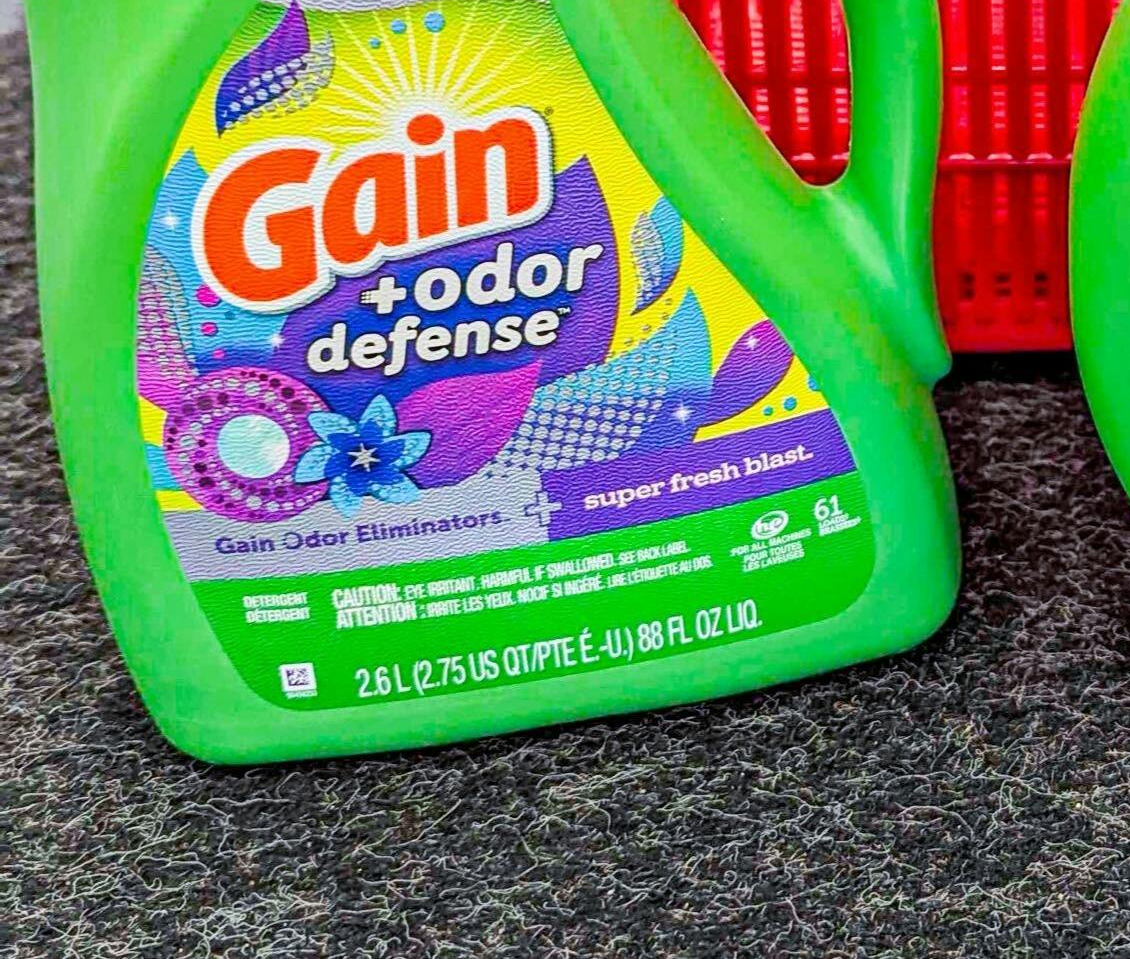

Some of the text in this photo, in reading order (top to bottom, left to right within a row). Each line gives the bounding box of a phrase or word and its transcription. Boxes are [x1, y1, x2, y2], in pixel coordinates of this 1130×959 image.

[201, 111, 543, 305] Gain
[583, 480, 666, 511] super
[667, 463, 741, 495] fresh
[814, 494, 843, 522] 61
[215, 533, 276, 555] Gain
[282, 528, 350, 550] Odor
[769, 528, 812, 547] MACHINES
[241, 590, 309, 609] DETERGENT
[331, 582, 403, 610] CAUTION:
[404, 583, 427, 601] EYE
[480, 567, 532, 591] HARMFUL
[533, 564, 547, 583] IF
[336, 600, 418, 630] ATTENTION
[517, 584, 550, 604] NOCIF
[551, 582, 564, 599] SI
[354, 664, 392, 699] 2.6
[393, 662, 412, 694] L
[412, 654, 468, 696] (2.75
[468, 648, 500, 682] US
[502, 635, 577, 677] QT/PTE
[637, 620, 665, 654] 88
[666, 614, 693, 647] FL
[695, 606, 725, 641] OZ
[726, 598, 764, 635] LIQ.
